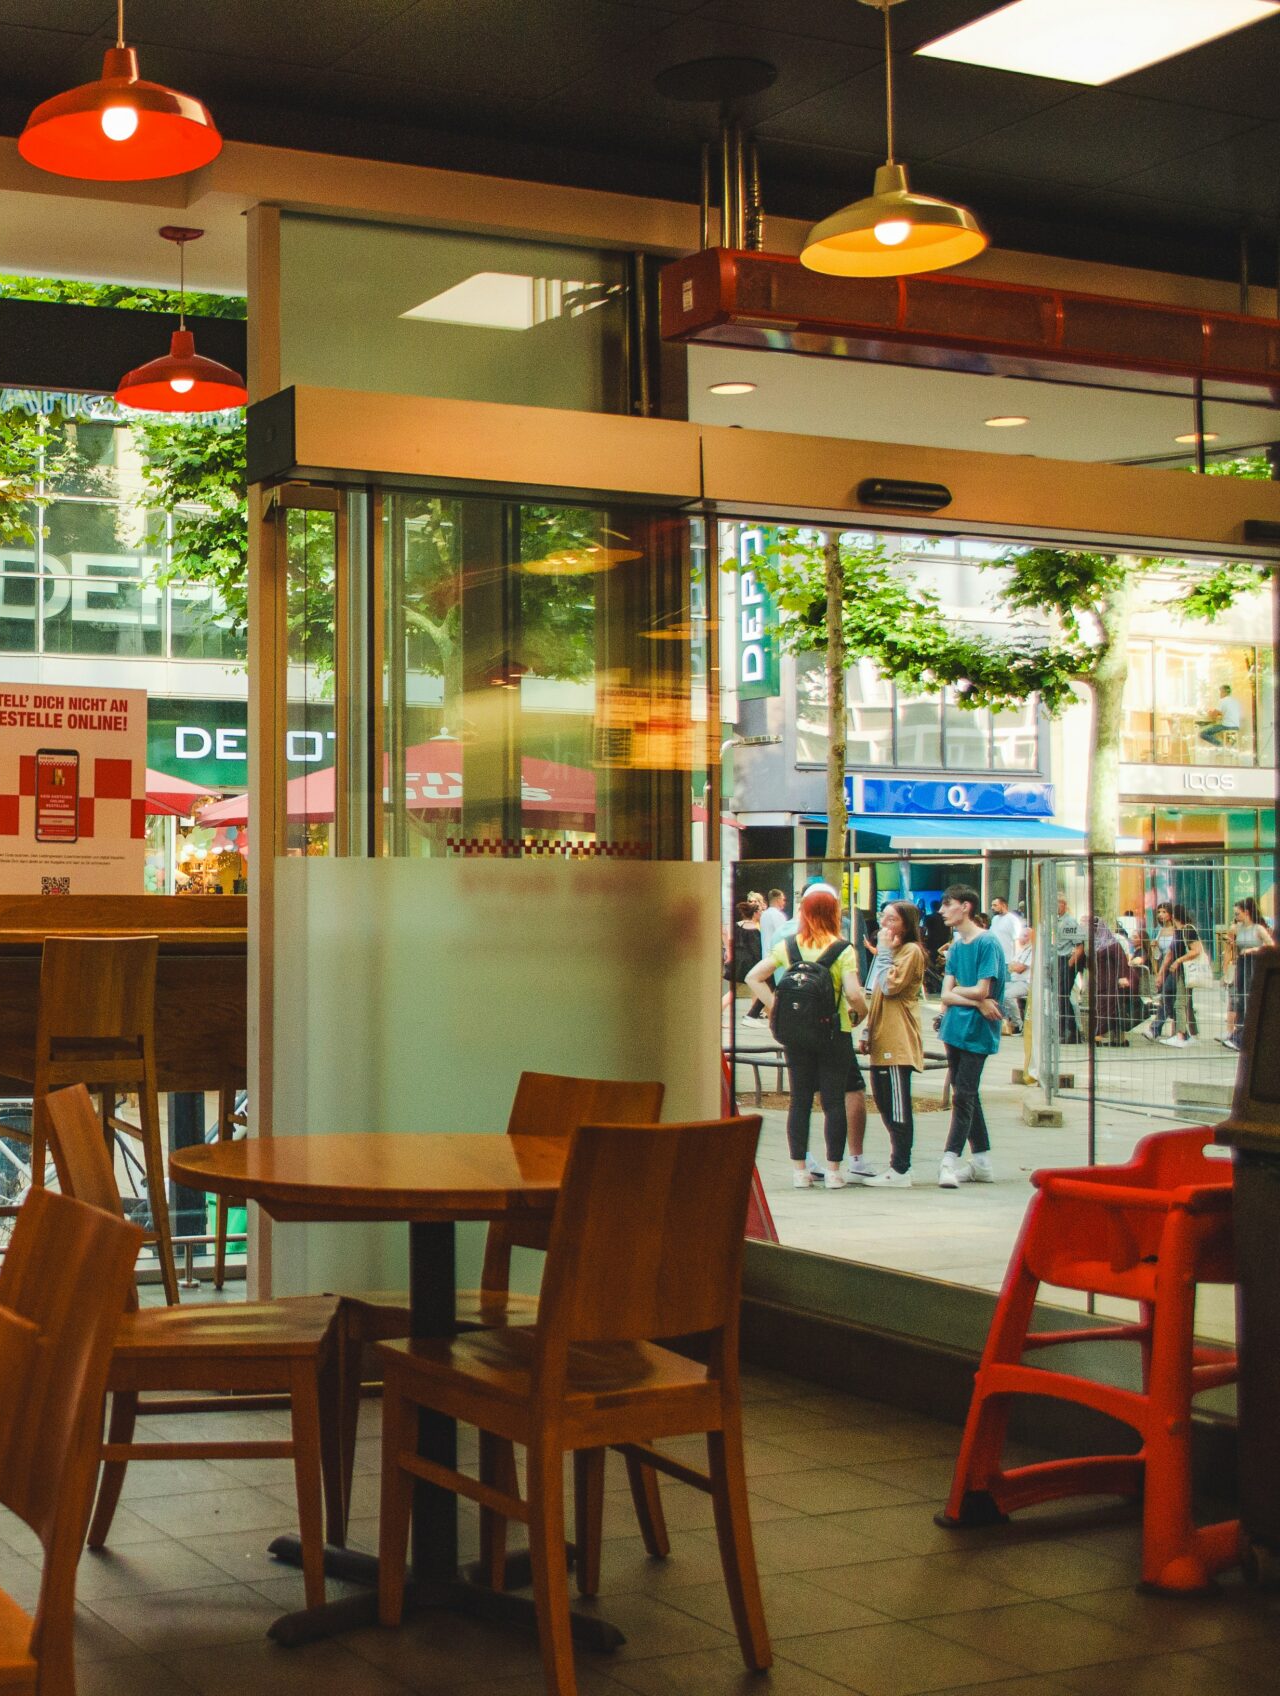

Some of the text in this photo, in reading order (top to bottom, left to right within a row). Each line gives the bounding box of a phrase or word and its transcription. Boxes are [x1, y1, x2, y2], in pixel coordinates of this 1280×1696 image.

[740, 521, 764, 682] DEPO
[34, 695, 64, 709] DICH
[69, 697, 107, 711] NICHT
[110, 700, 128, 712] AN
[67, 714, 128, 731] ONLINE!
[176, 727, 336, 762] DEO
[1184, 773, 1235, 793] IQOS
